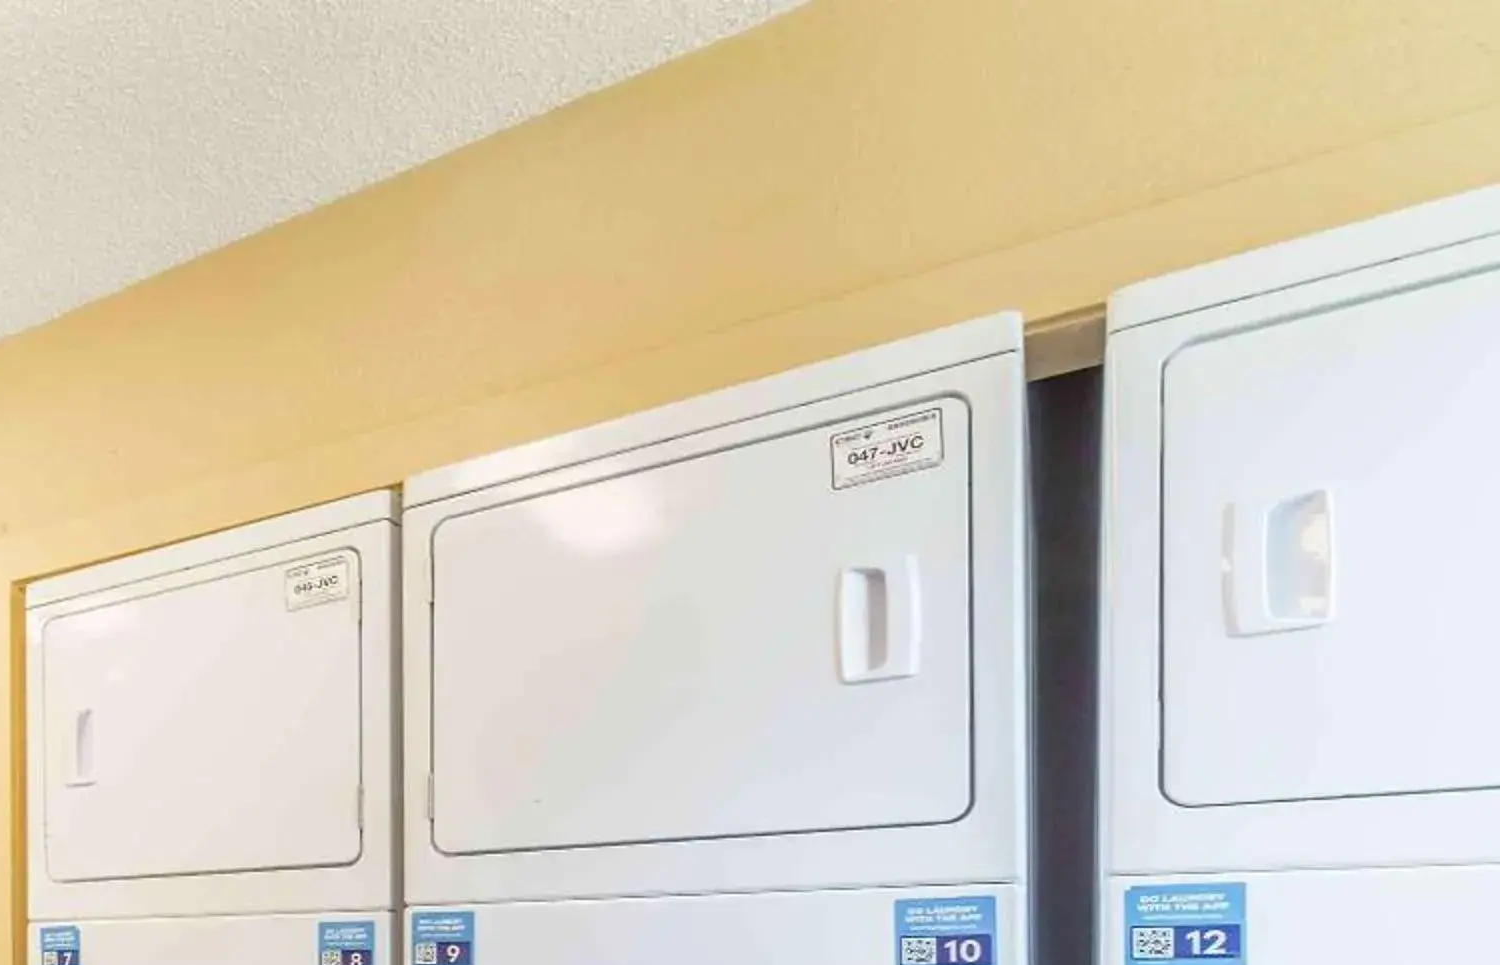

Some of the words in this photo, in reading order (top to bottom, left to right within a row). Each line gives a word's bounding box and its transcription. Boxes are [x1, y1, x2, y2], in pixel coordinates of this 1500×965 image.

[847, 435, 925, 466] 047-JVC
[446, 944, 460, 963] 9
[943, 939, 982, 963] 10
[1184, 929, 1227, 955] 12
